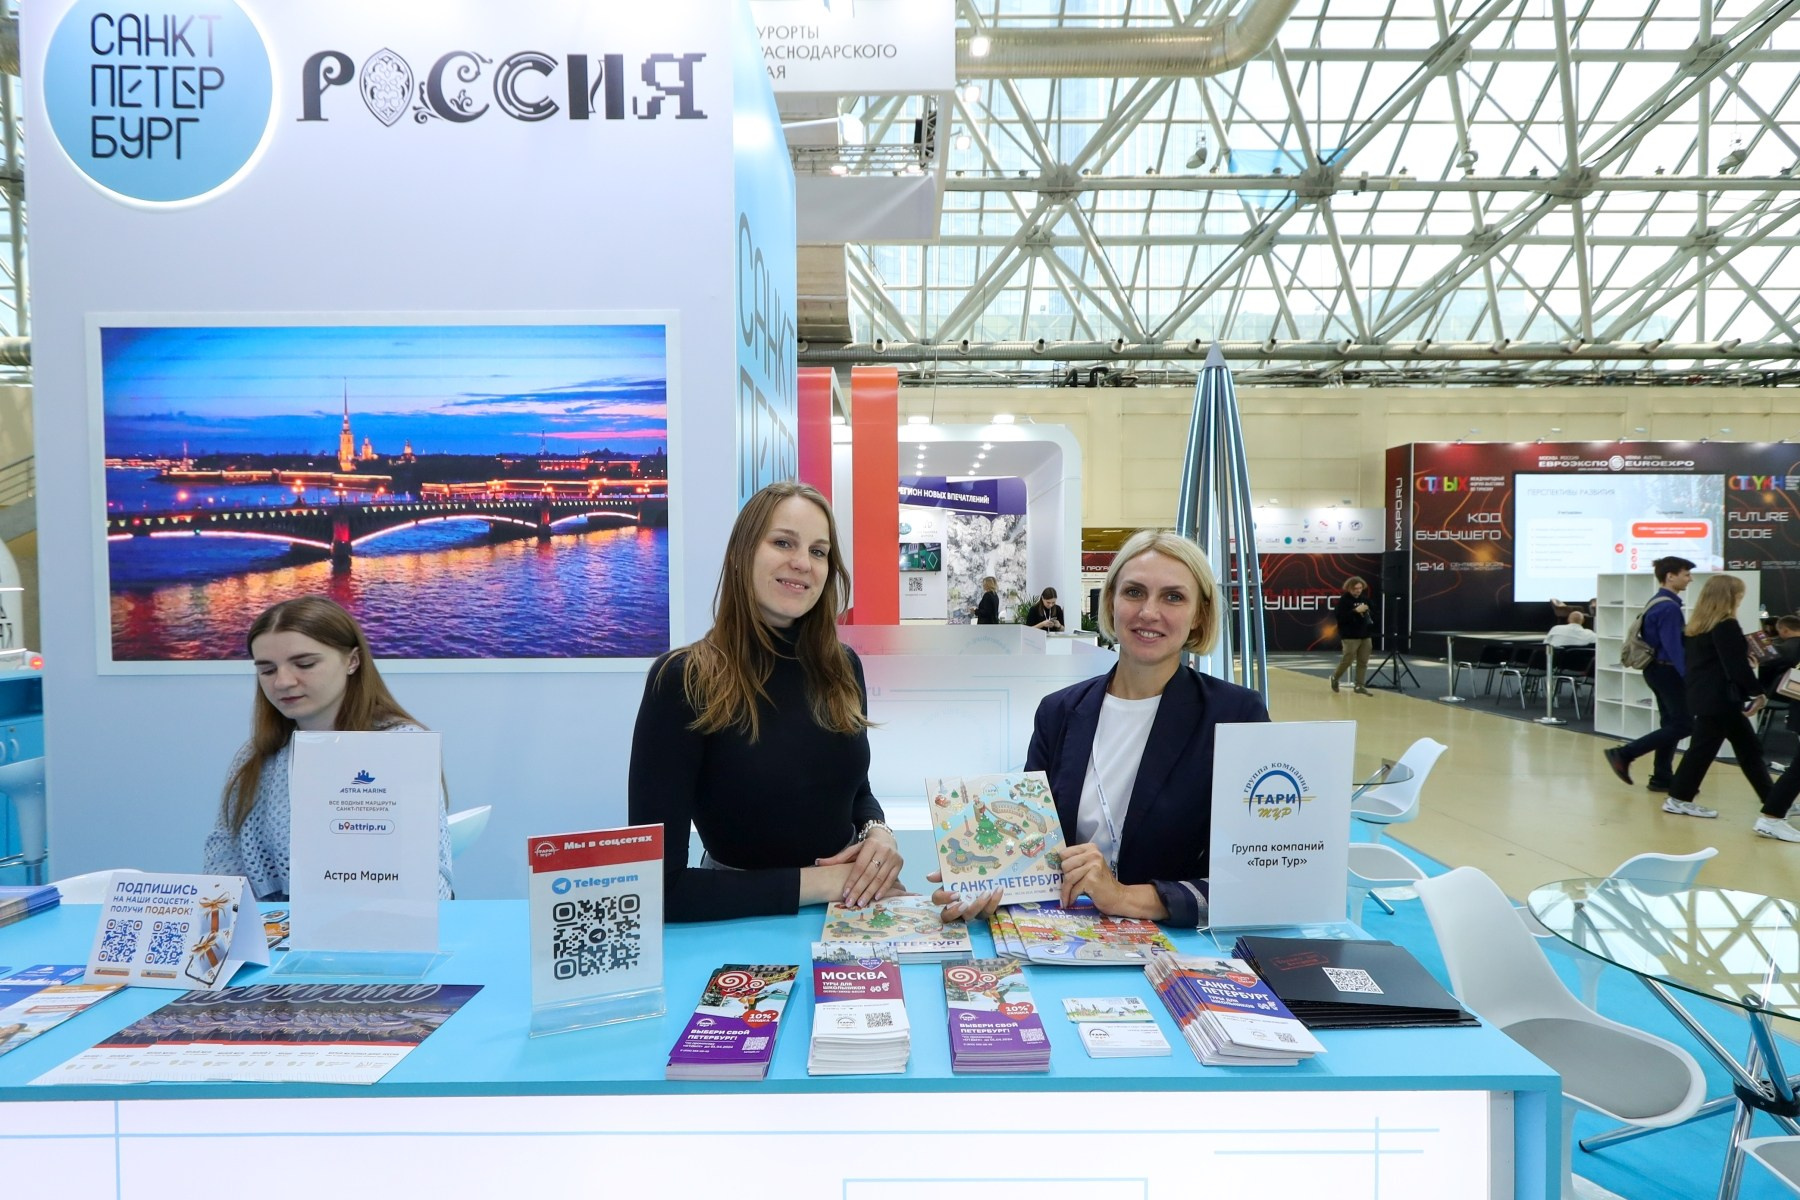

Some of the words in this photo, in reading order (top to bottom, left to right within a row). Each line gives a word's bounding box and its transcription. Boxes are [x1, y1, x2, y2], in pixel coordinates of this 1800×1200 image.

[91, 14, 220, 57] САНКТ
[756, 26, 819, 40] УРОРТЫ
[761, 44, 897, 61] АСНОДАРСКОГО
[767, 65, 786, 79] АЯ
[91, 65, 225, 110] ПЕТЕР
[297, 47, 708, 127] РОССИЯ
[91, 117, 200, 160] БУРГ
[1538, 460, 1608, 468] ЕВРОЭКСПО
[1625, 460, 1695, 468] EUROEXPO
[923, 489, 947, 500] НОВЫХ
[947, 492, 990, 504] ВПЕЧАТЛЕНИЙ!
[1468, 512, 1502, 523] КОД
[1728, 511, 1789, 522] FUTURE
[1728, 529, 1772, 539] CODE
[1255, 794, 1296, 805] ТАРИ
[564, 841, 585, 850] Мы
[598, 835, 653, 847] соцсетях
[1232, 843, 1268, 855] Группа
[1271, 841, 1325, 852] компаний
[1247, 857, 1279, 867] «Тари
[1282, 856, 1307, 867] Тур»
[324, 870, 357, 883] Астра
[360, 871, 399, 884] Марин
[573, 874, 639, 889] Telegram
[116, 882, 198, 895] ПОДПИШИСЬ
[153, 897, 189, 905] СОЦСЕТИ
[110, 905, 143, 913] ПОЛУЧИ
[145, 906, 193, 915] ПОДАРОК!
[821, 971, 888, 980] МОСКВА
[1197, 979, 1241, 990] САНКТ-
[1201, 987, 1269, 1001] ПЕТЕРБУРГ
